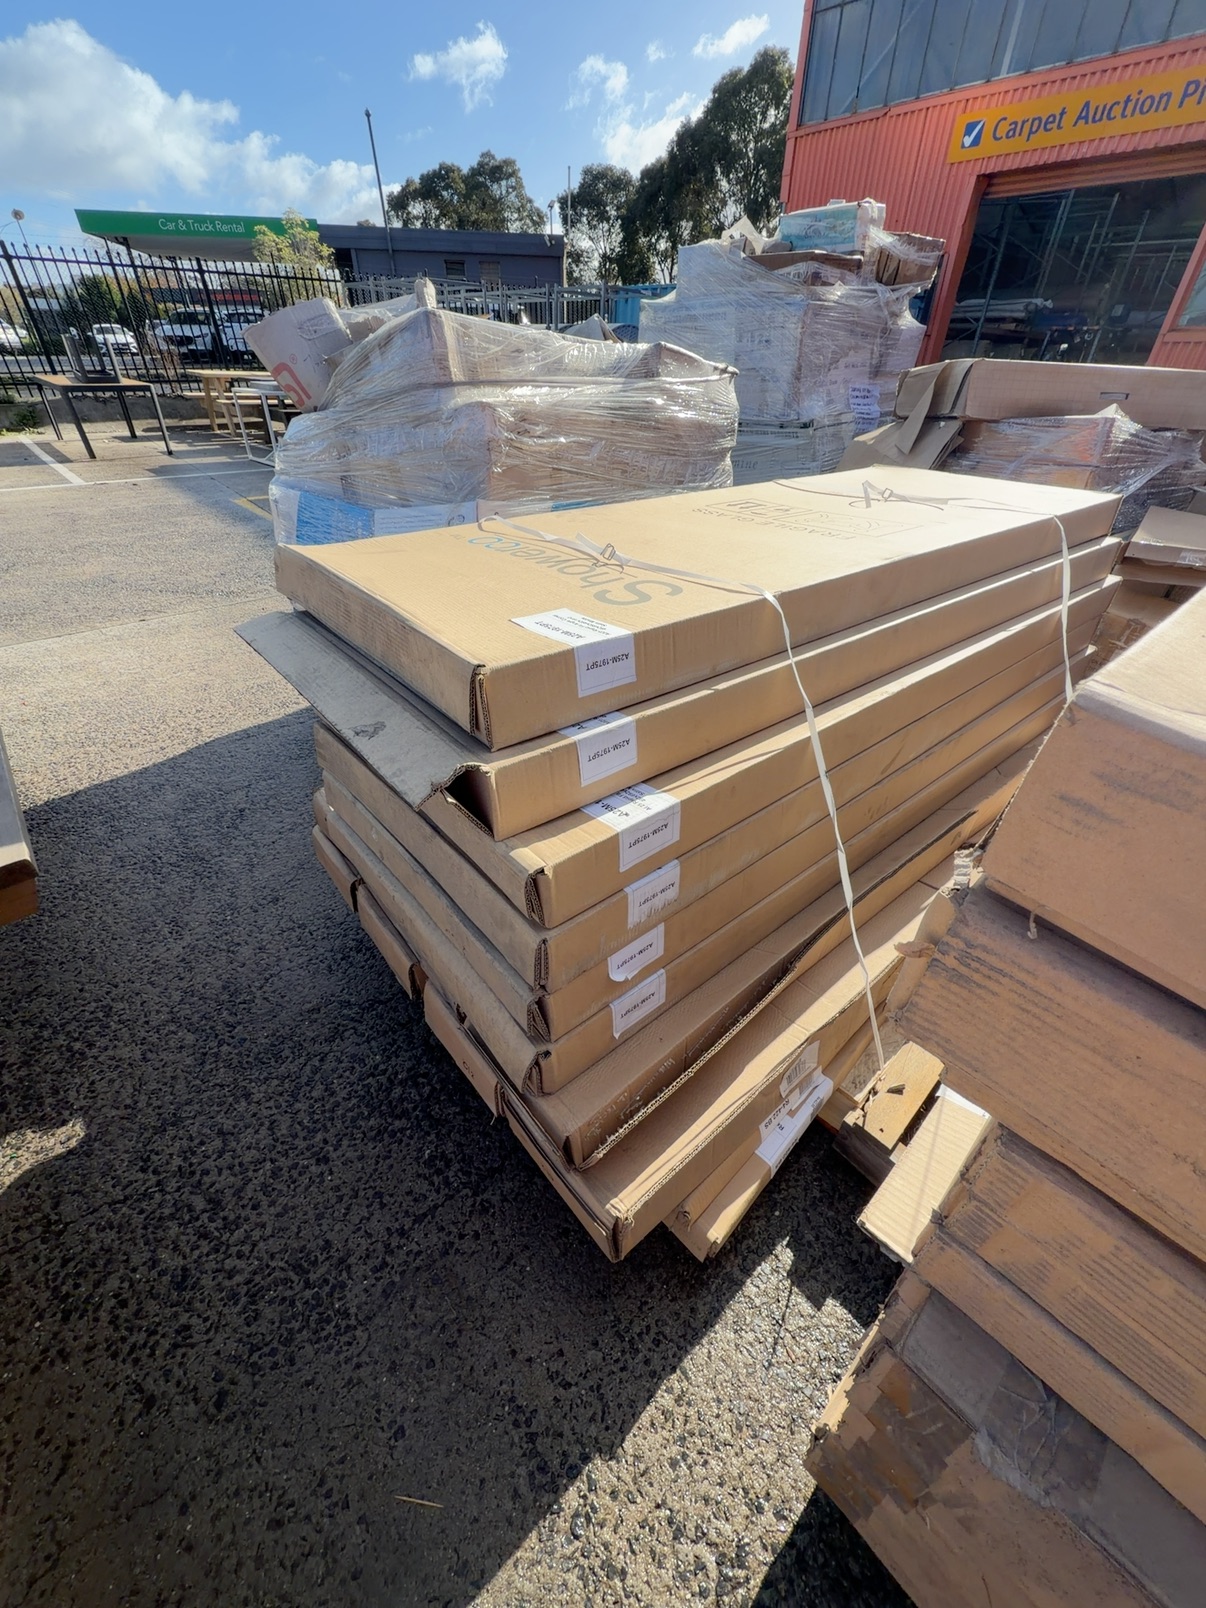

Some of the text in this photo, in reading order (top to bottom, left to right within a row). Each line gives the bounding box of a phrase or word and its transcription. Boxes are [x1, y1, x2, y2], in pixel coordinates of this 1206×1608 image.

[992, 107, 1067, 142] Carpet
[1073, 89, 1173, 127] Auction
[158, 218, 246, 233] Car & Truck Rental
[691, 507, 857, 541] FRAGILE GLASS
[467, 536, 684, 606] Showerco
[585, 652, 630, 672] A25M-1975PT
[587, 738, 631, 763] A25M-1975PT
[628, 822, 669, 849] A25M-1975PT
[638, 881, 676, 908] A25M-1975PT
[616, 942, 654, 970] A25M-1975PT
[620, 991, 656, 1020] A25M-1975PT
